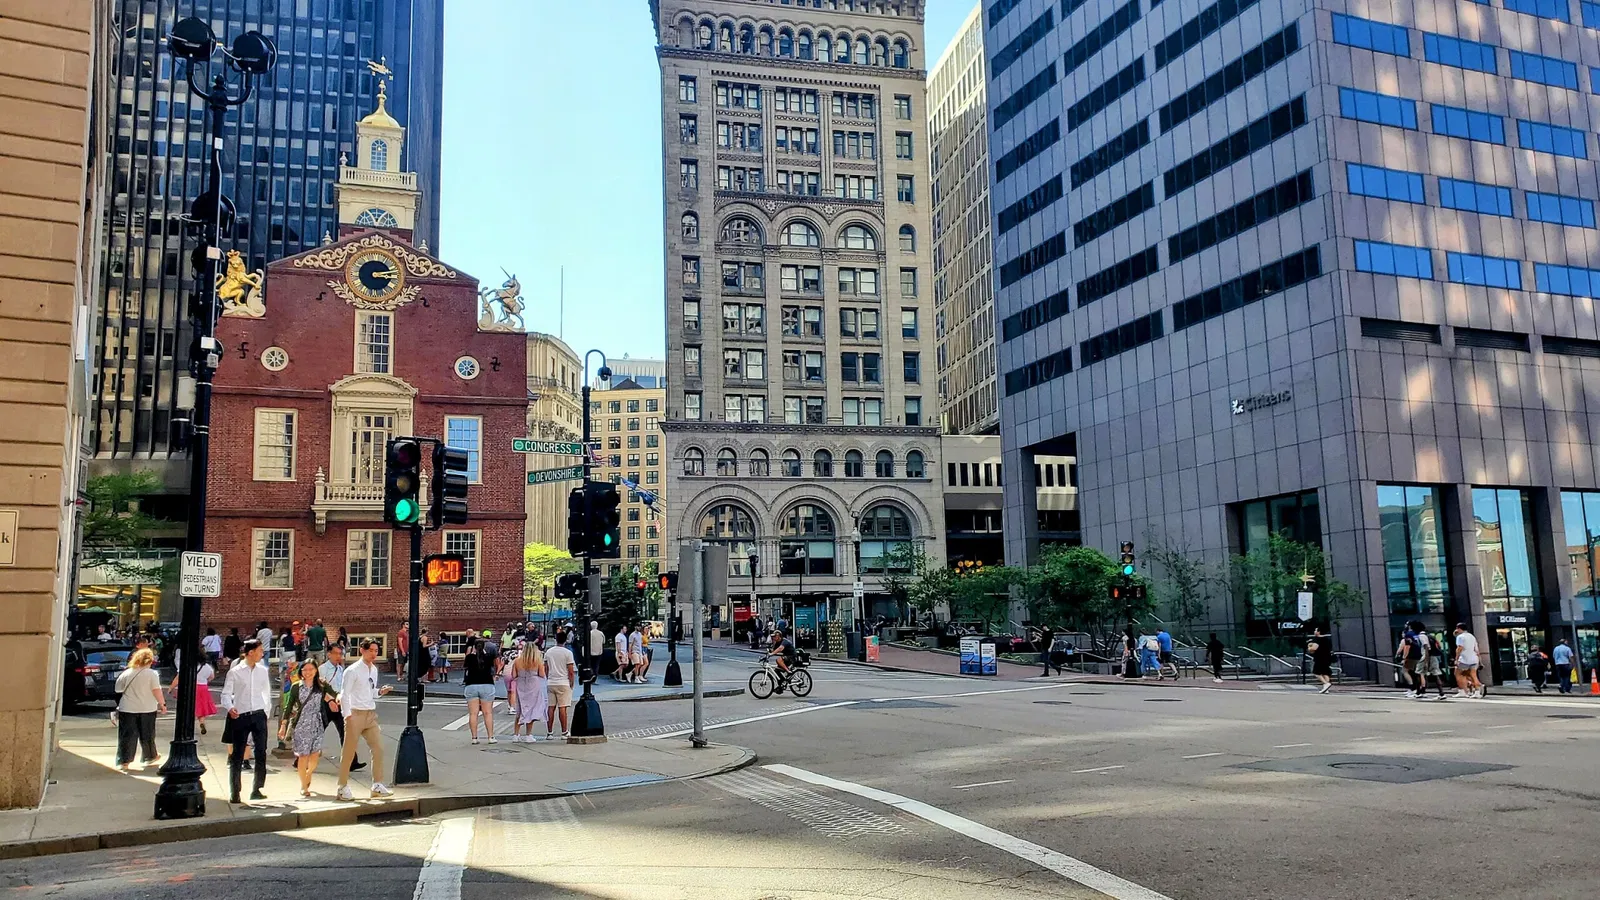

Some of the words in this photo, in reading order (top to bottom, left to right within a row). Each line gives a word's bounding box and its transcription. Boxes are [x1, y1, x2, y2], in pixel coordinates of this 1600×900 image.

[525, 441, 572, 454] CONGRESS
[536, 468, 576, 482] DEVONSHIRE
[186, 556, 217, 568] YIELD
[442, 561, 459, 581] 20
[183, 574, 217, 584] PEDESTRIANS
[194, 584, 215, 594] TURNS
